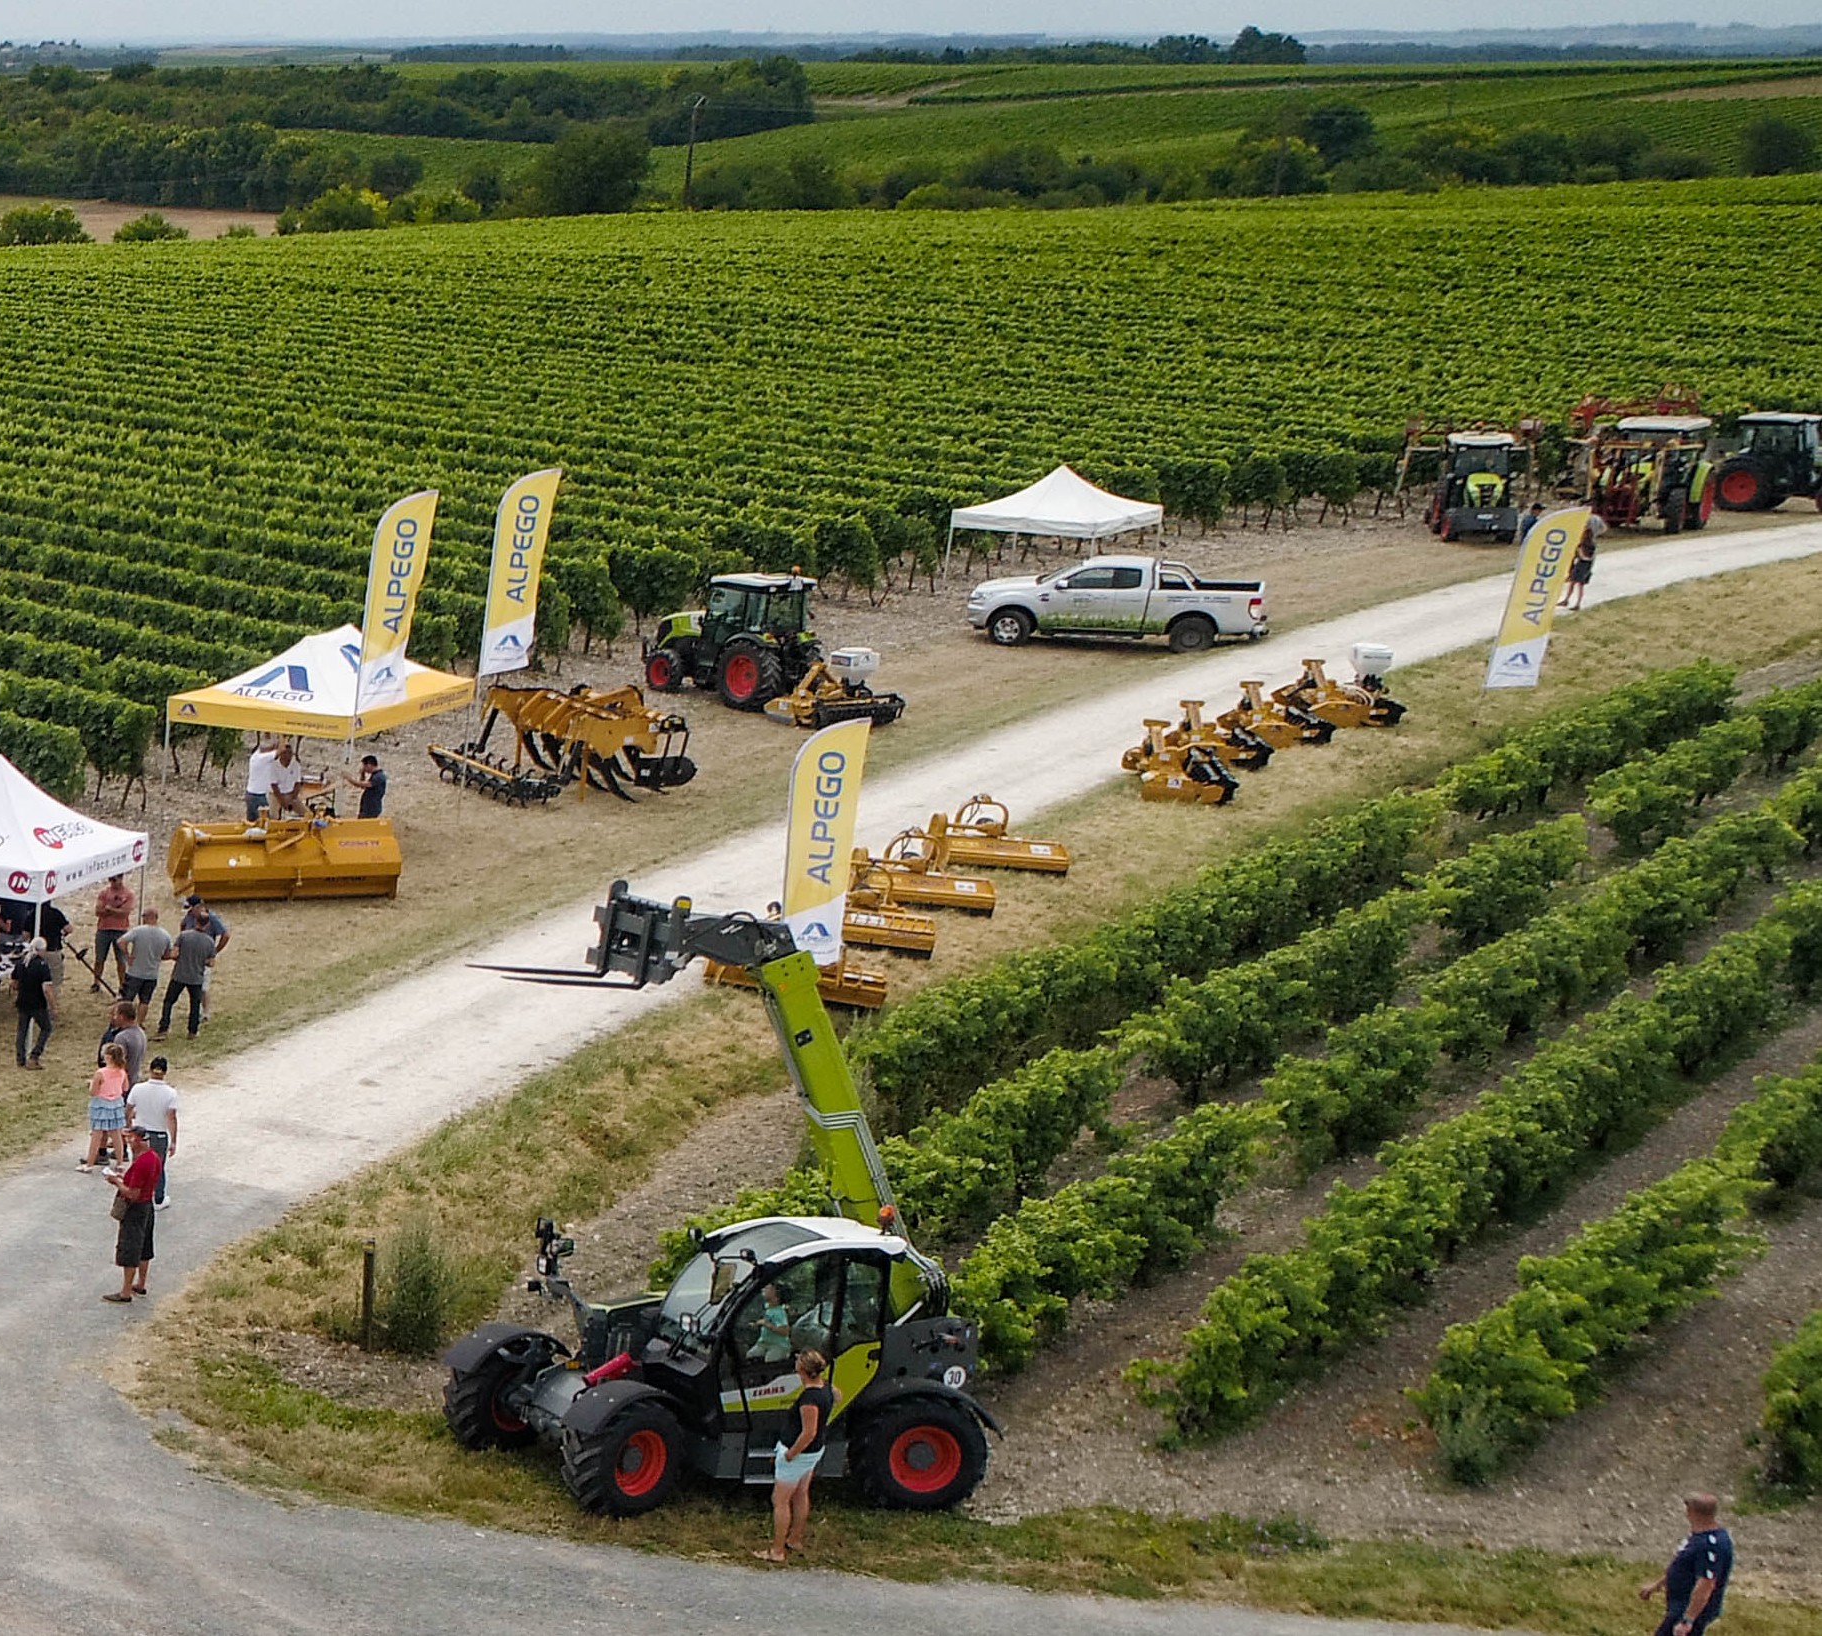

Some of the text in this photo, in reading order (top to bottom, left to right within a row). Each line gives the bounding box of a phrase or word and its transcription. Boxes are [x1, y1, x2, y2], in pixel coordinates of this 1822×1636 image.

[383, 518, 418, 634] ALPEGO
[506, 495, 540, 603] ALPEGO
[1522, 528, 1567, 626] ALPEGO
[232, 687, 315, 703] ALPEGO
[807, 751, 846, 885] ALPEGO
[9, 873, 31, 891] IN
[752, 1385, 786, 1398] CLAAS
[946, 1370, 962, 1386] 30
